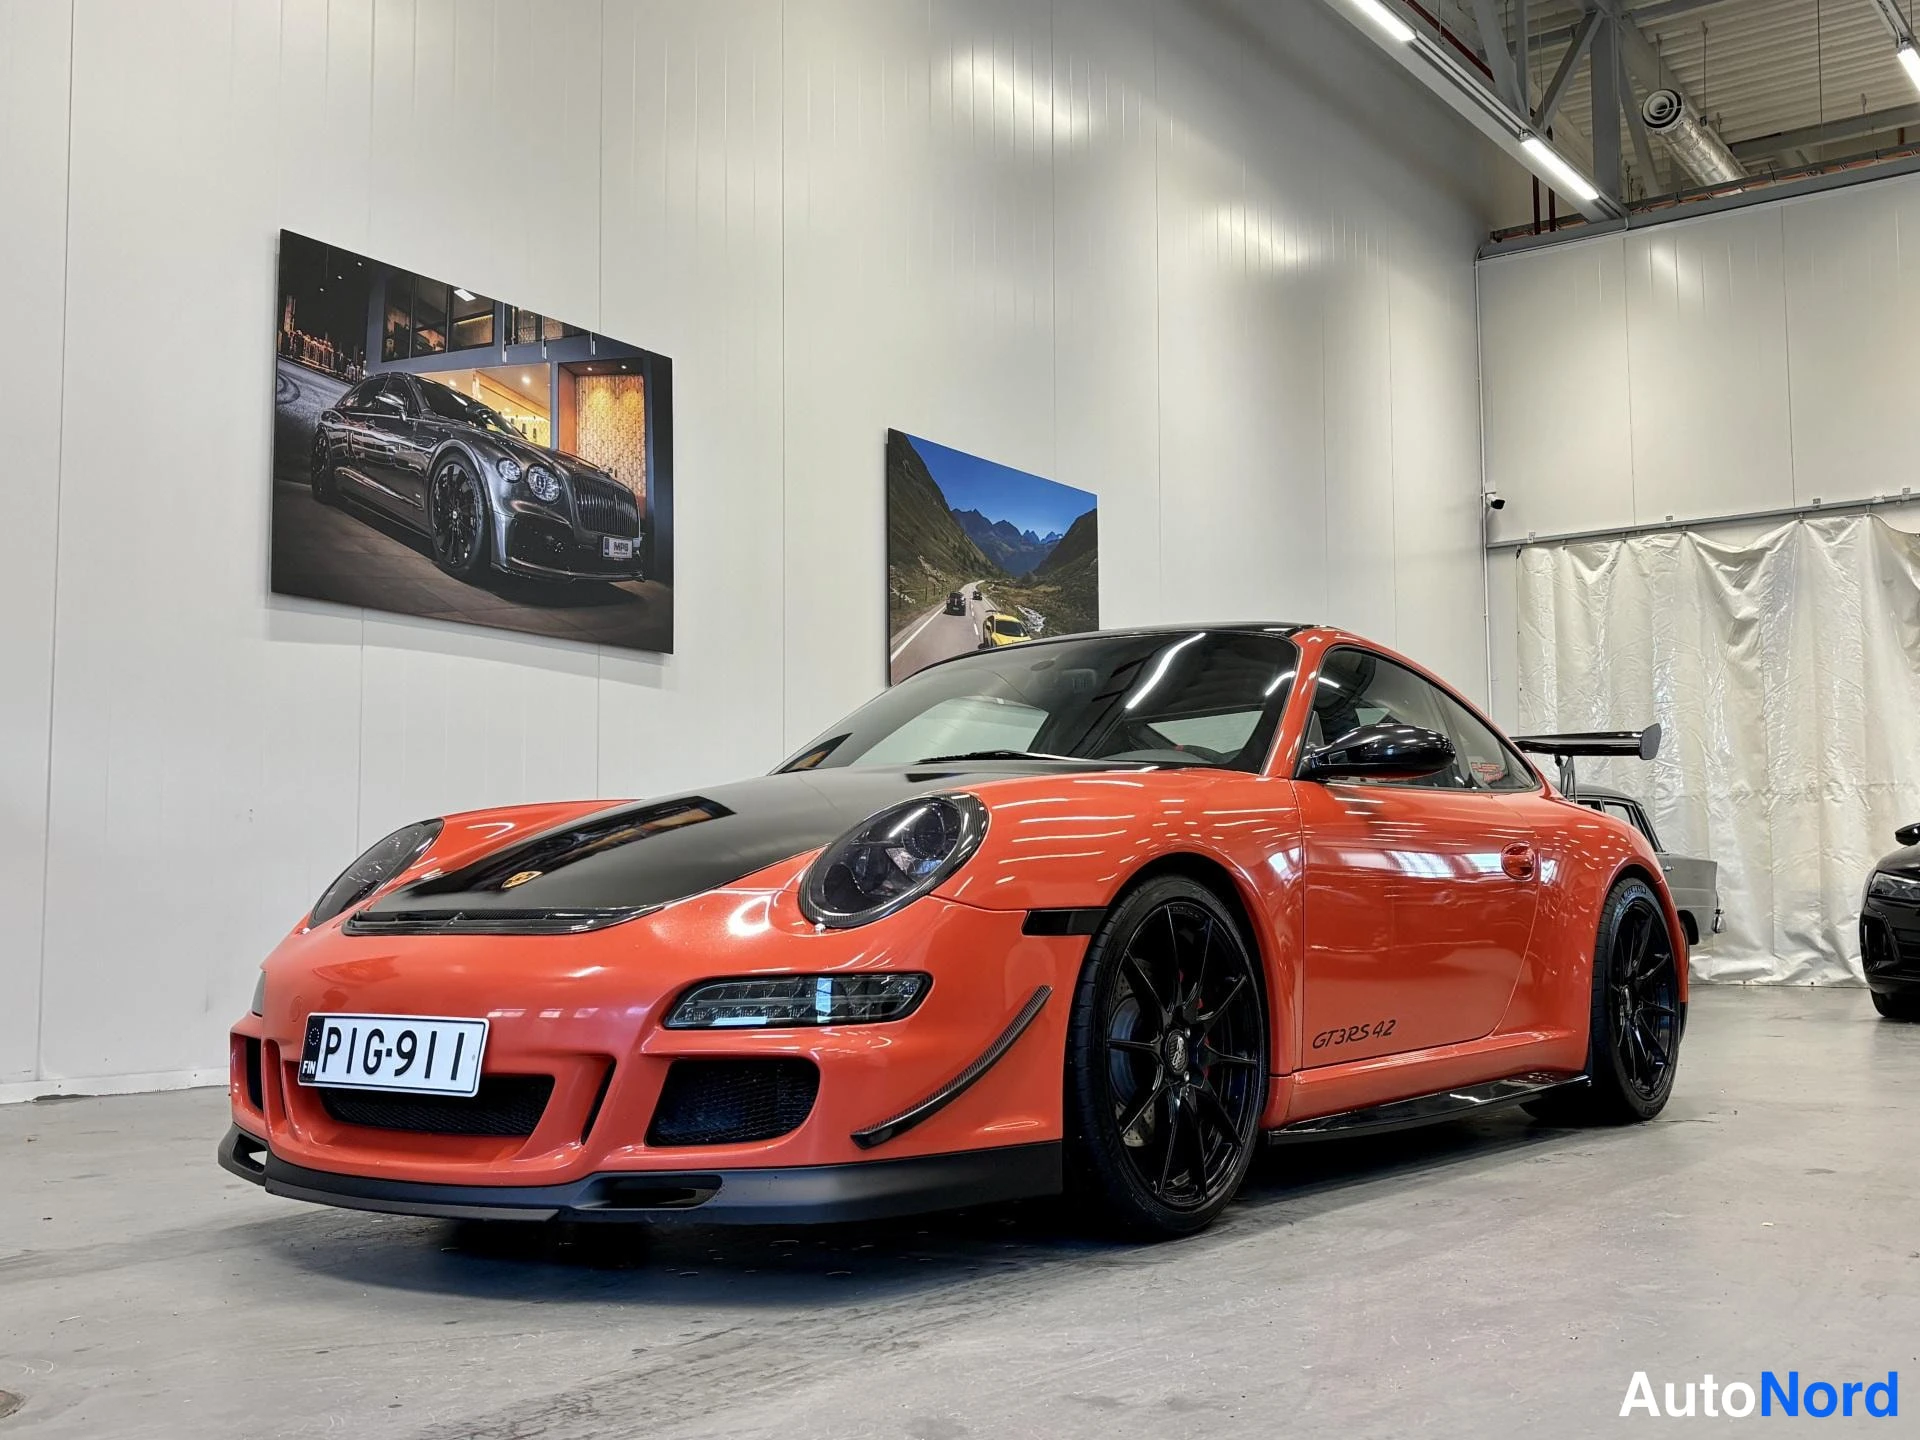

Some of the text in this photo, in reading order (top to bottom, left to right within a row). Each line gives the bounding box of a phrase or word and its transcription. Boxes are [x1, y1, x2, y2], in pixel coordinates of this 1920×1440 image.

[1312, 1024, 1370, 1049] GT3RS
[321, 1026, 465, 1081] PIG-911
[301, 1060, 317, 1075] FIN
